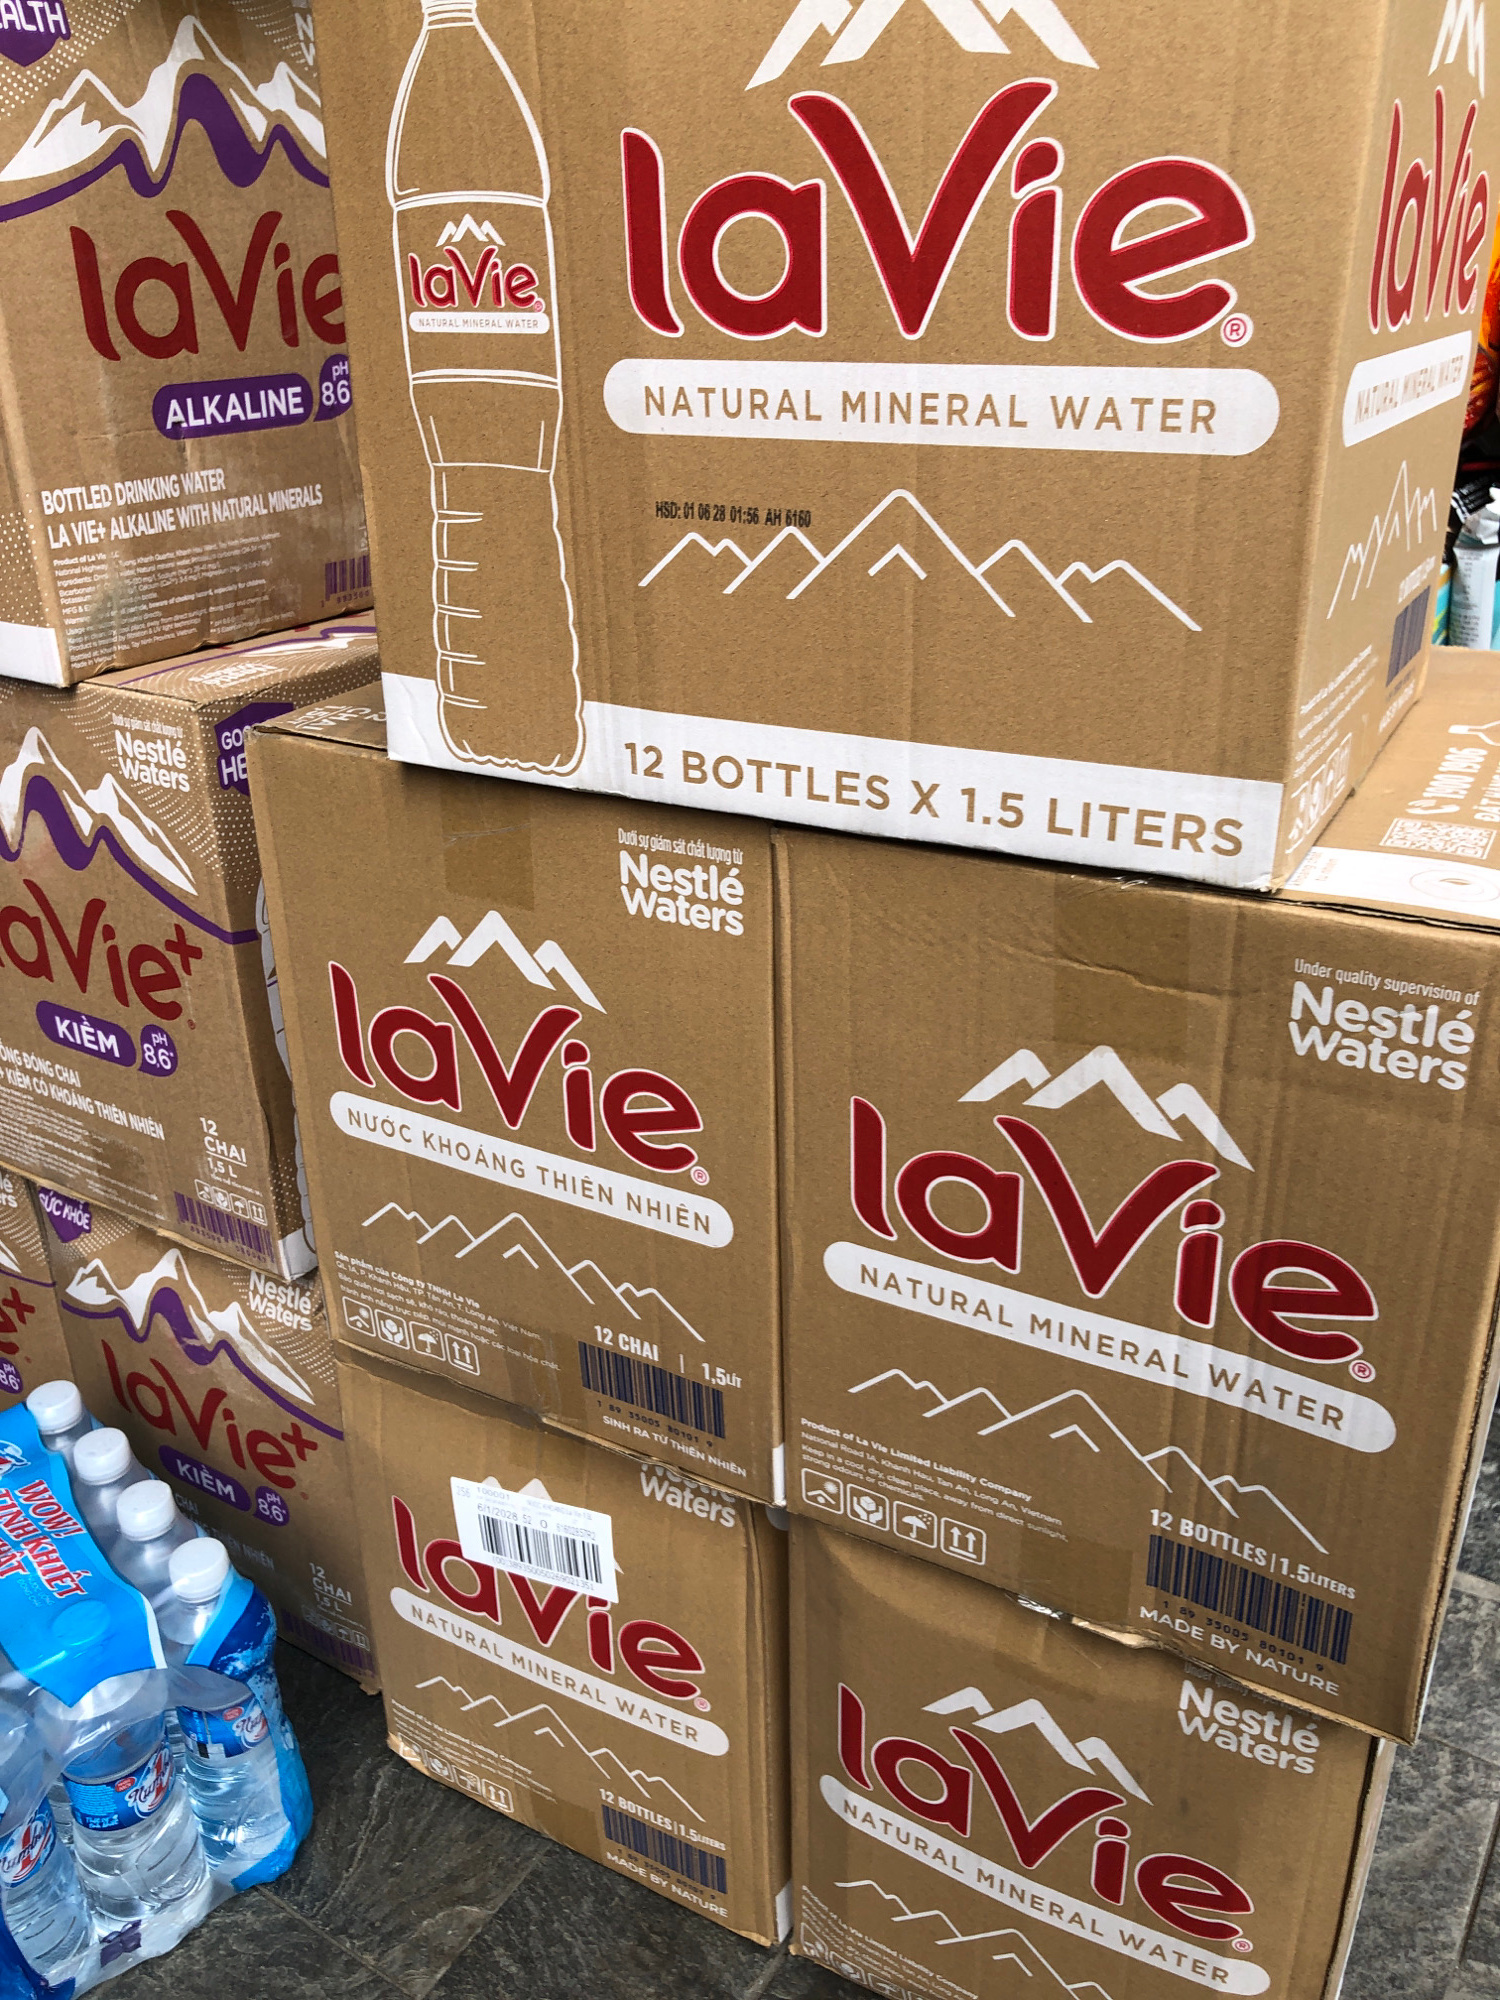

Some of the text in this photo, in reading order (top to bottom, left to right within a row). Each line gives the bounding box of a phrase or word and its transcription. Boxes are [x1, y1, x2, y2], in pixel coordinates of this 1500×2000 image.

[621, 77, 1255, 343] laVie
[1368, 85, 1489, 334] laVie
[70, 210, 346, 361] laVie
[408, 245, 539, 308] laVie
[418, 318, 539, 329] NATURAL MINERAL WATER
[332, 361, 349, 381] pH
[166, 386, 304, 429] ALKALINE
[644, 385, 1217, 435] NATURAL MINERAL WATER
[41, 468, 226, 515] BOTTLED DRINKING WATER
[48, 484, 323, 549] LA VIE+ ALKALINE WITH NATURAL MINERALS
[655, 501, 681, 519] HSD:
[683, 502, 695, 519] 01
[713, 504, 726, 522] 28
[730, 506, 759, 525] 01:56
[764, 508, 782, 526] AH
[115, 729, 187, 769] Nestlé
[118, 756, 190, 792] Waters
[625, 742, 1242, 858] 12 BOTTLES X 1.5 LITERS
[619, 850, 745, 905] Nestlé
[620, 884, 745, 937] Waters
[1294, 958, 1481, 1006] Under quality supervision of
[54, 1015, 120, 1059] KIỀM
[151, 1033, 169, 1047] pH
[1290, 980, 1476, 1055] Nestlé
[55, 1064, 82, 1088] CHAI
[329, 960, 703, 1173] laVie
[1288, 1021, 1469, 1091] Waters
[6, 1065, 165, 1141] KIỀM CÓ KHOÁNG THIÊN NHIÊN
[200, 1117, 218, 1136] 12
[204, 1137, 246, 1163] CHAI
[228, 1165, 238, 1178] L
[347, 1105, 711, 1236] NƯỚC KHOÁNG THIÊN NHIÊN
[850, 1095, 1380, 1364] laVie
[249, 1269, 312, 1315] Nestlé
[249, 1290, 313, 1331] Waters
[416, 1279, 426, 1290] ty
[427, 1282, 451, 1298] TNHH
[452, 1292, 465, 1303] La
[465, 1296, 480, 1309] Vie
[594, 1324, 614, 1346] 12
[618, 1333, 660, 1362] CHAI
[859, 1263, 1345, 1432] NATURAL MINERAL WATER
[602, 1415, 747, 1478] SINH RA TỪ THIÊN NHIÊN
[801, 1417, 1033, 1502] Product of La Vie Limited Liability Company
[14, 1479, 89, 1539] WOW!
[477, 1503, 518, 1522] 6/1/2028
[640, 1471, 736, 1528] Waters
[1149, 1509, 1175, 1531] 12
[1178, 1518, 1268, 1567] BOTTLES
[309, 1562, 326, 1580] 12
[312, 1576, 353, 1604] CHAI
[410, 1604, 504, 1659] NATURAL
[511, 1654, 606, 1705] MINERAL
[615, 1695, 699, 1743] WATER
[1139, 1606, 1341, 1697] MADE BY NATURE
[1177, 1710, 1316, 1775] Waters
[1178, 1679, 1320, 1754] Nestlé
[599, 1788, 615, 1803] 12
[617, 1796, 673, 1830] BOTTLES
[838, 1682, 1256, 1941] laVie
[606, 1851, 648, 1878] MADE
[650, 1874, 669, 1888] BY
[671, 1883, 729, 1918] NATURE
[842, 1797, 1230, 1985] NATURAL MINERAL WATER
